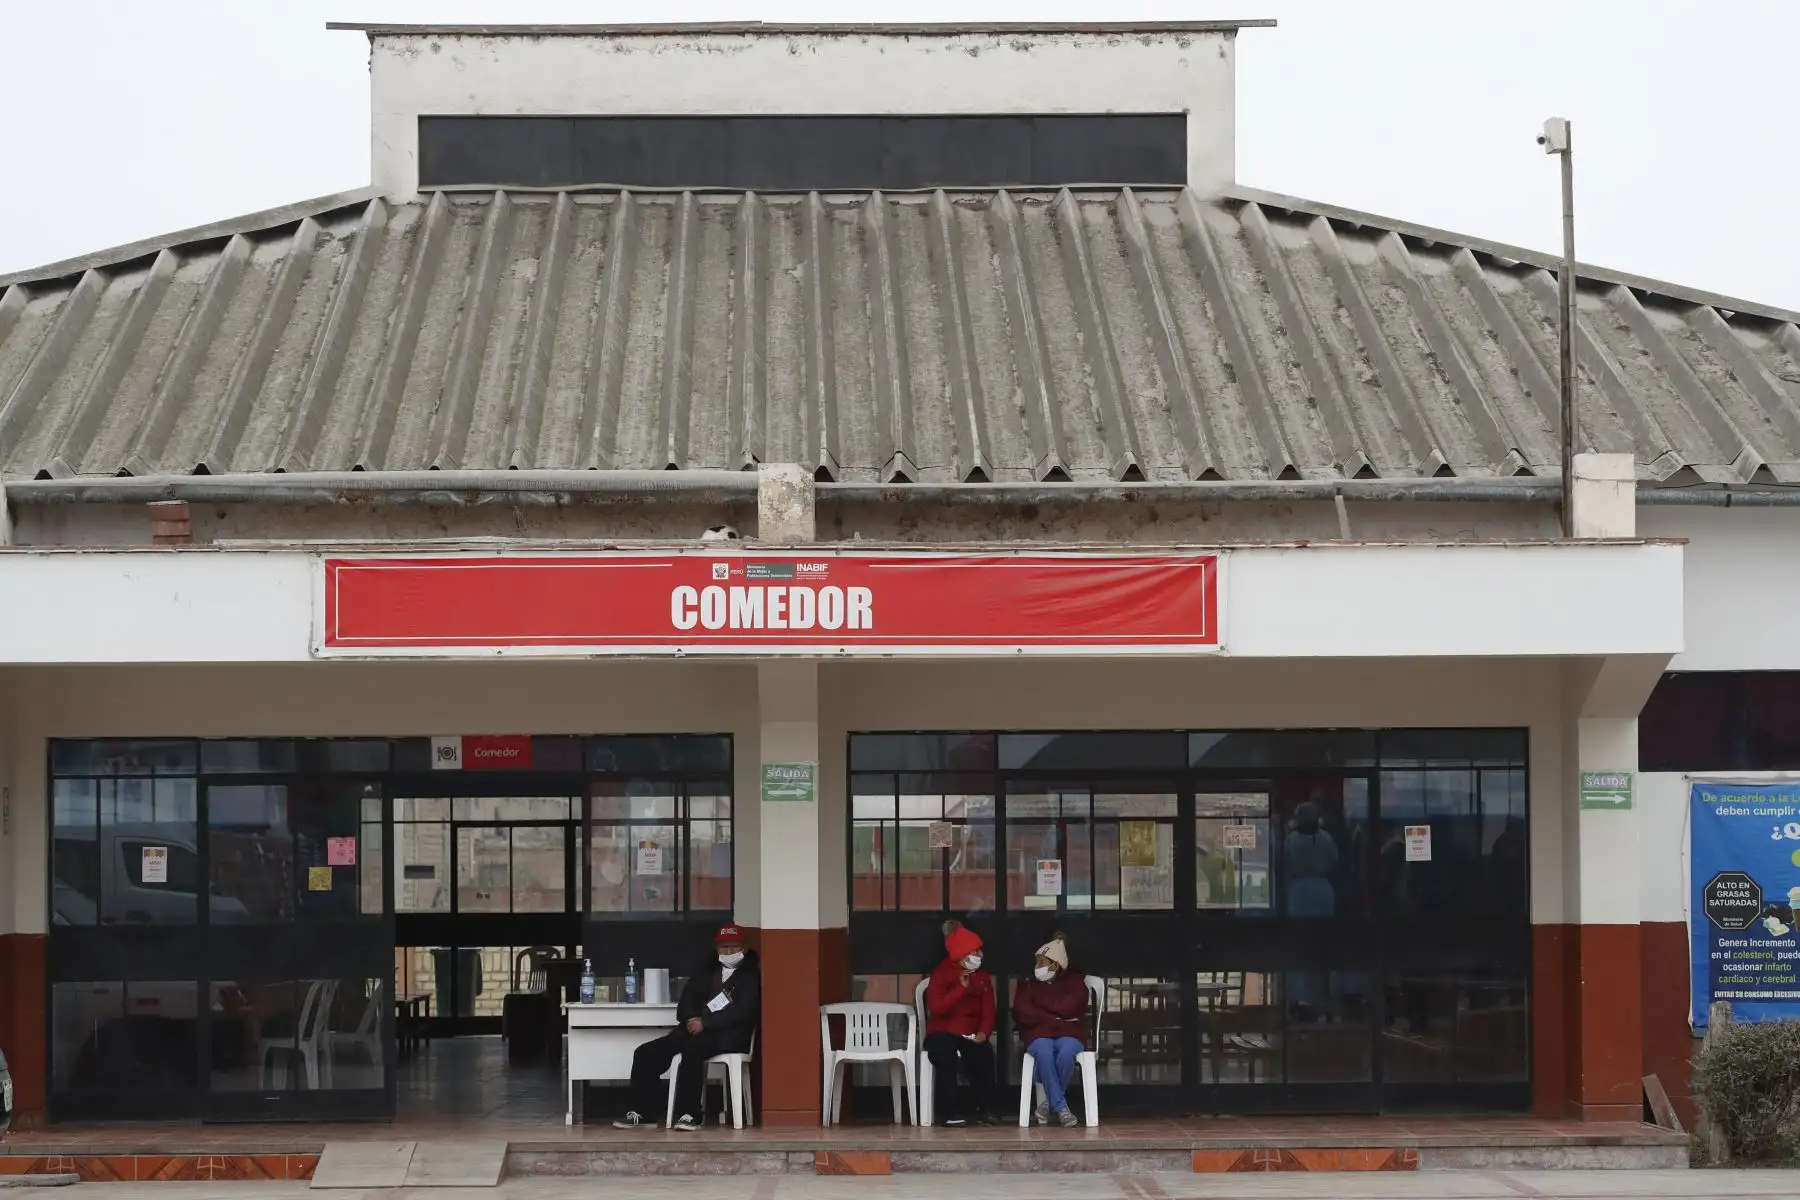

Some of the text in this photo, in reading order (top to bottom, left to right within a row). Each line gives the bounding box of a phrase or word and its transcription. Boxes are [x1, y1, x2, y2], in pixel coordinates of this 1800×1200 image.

[796, 564, 828, 572] INABIF
[671, 586, 873, 630] COMEDOR
[474, 748, 520, 757] Comedor
[767, 768, 809, 778] SALIDA
[1585, 776, 1627, 786] SALIDA
[1702, 791, 1716, 802] De
[1720, 792, 1765, 803] acuerdo
[1768, 795, 1775, 803] a
[1792, 792, 1800, 803] L
[1716, 806, 1750, 816] deben
[1753, 806, 1796, 817] cumplir
[1718, 938, 1796, 947] Genera Incremento
[1724, 950, 1730, 958] el
[1733, 950, 1776, 960] colesterol,
[1723, 962, 1792, 970] ocasionar infarto
[1756, 976, 1760, 986] y
[1762, 974, 1796, 982] cerebral
